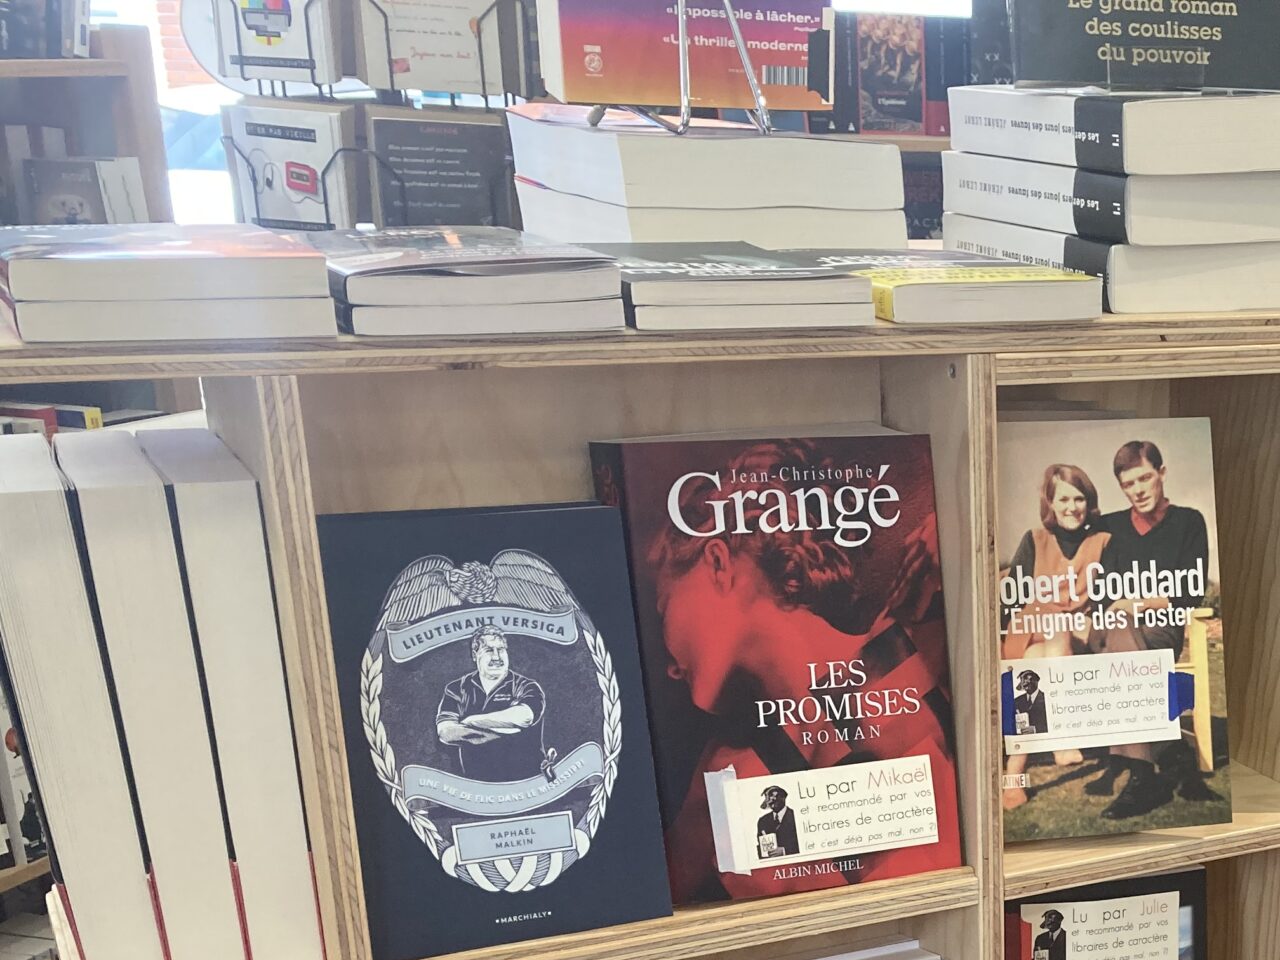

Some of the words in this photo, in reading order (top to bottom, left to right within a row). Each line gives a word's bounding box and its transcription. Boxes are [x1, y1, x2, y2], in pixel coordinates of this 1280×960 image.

[1174, 0, 1238, 17] roman
[1085, 18, 1122, 37] des
[1128, 20, 1223, 41] coulisses
[747, 39, 809, 52] moderne
[1097, 43, 1125, 60] du
[1131, 48, 1211, 68] pouvoir
[729, 465, 874, 485] Jean-Christophe
[666, 463, 901, 547] Grangé
[1000, 565, 1077, 605] obert
[1086, 558, 1205, 600] Goddard
[1092, 607, 1128, 629] des
[1133, 602, 1195, 629] Foster
[501, 617, 566, 636] VERSIGA
[755, 688, 922, 730] PROMISES
[798, 781, 816, 800] Lu
[826, 780, 857, 799] par
[868, 763, 928, 789] Mikaël
[817, 796, 882, 812] recommandé
[890, 792, 907, 803] par
[803, 819, 850, 833] libraires
[856, 813, 872, 825] de
[878, 806, 934, 823] caractère
[490, 827, 536, 840] RAPHAËL
[495, 838, 534, 848] MALKIN
[773, 866, 811, 880] ALBIN
[814, 859, 864, 875] MICHEL
[500, 912, 548, 923] MARCHIALY
